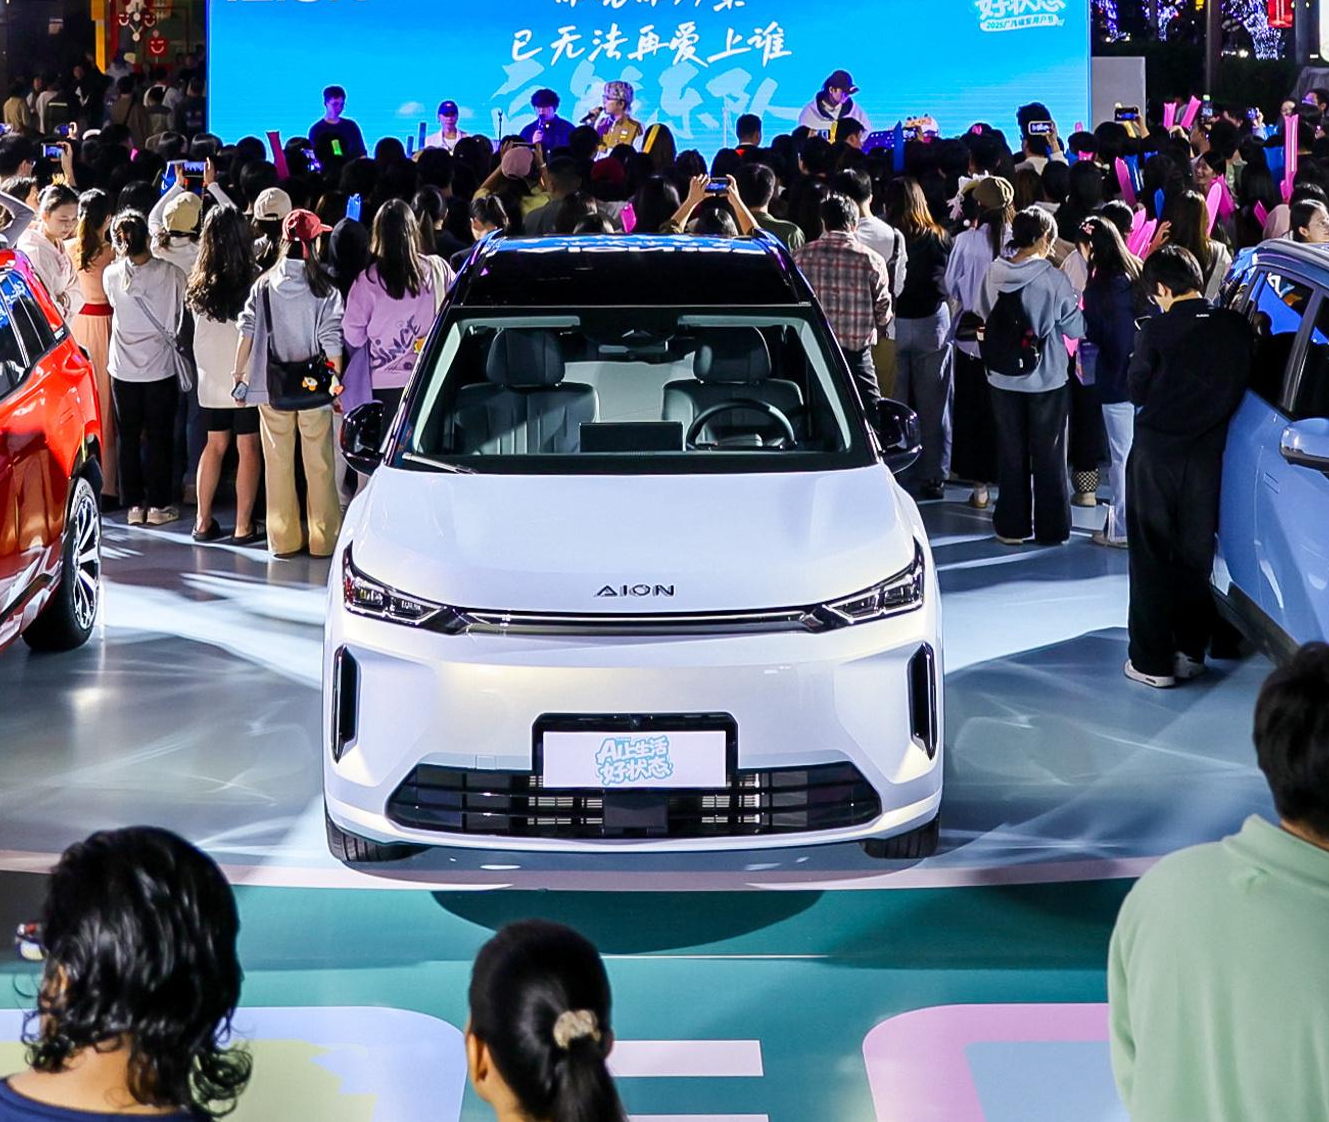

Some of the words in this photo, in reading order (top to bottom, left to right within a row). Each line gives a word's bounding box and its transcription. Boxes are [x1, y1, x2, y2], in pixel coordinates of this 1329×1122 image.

[511, 20, 793, 68] 已无法再爱上谁
[594, 584, 675, 597] AION
[599, 758, 673, 785] 好状态
